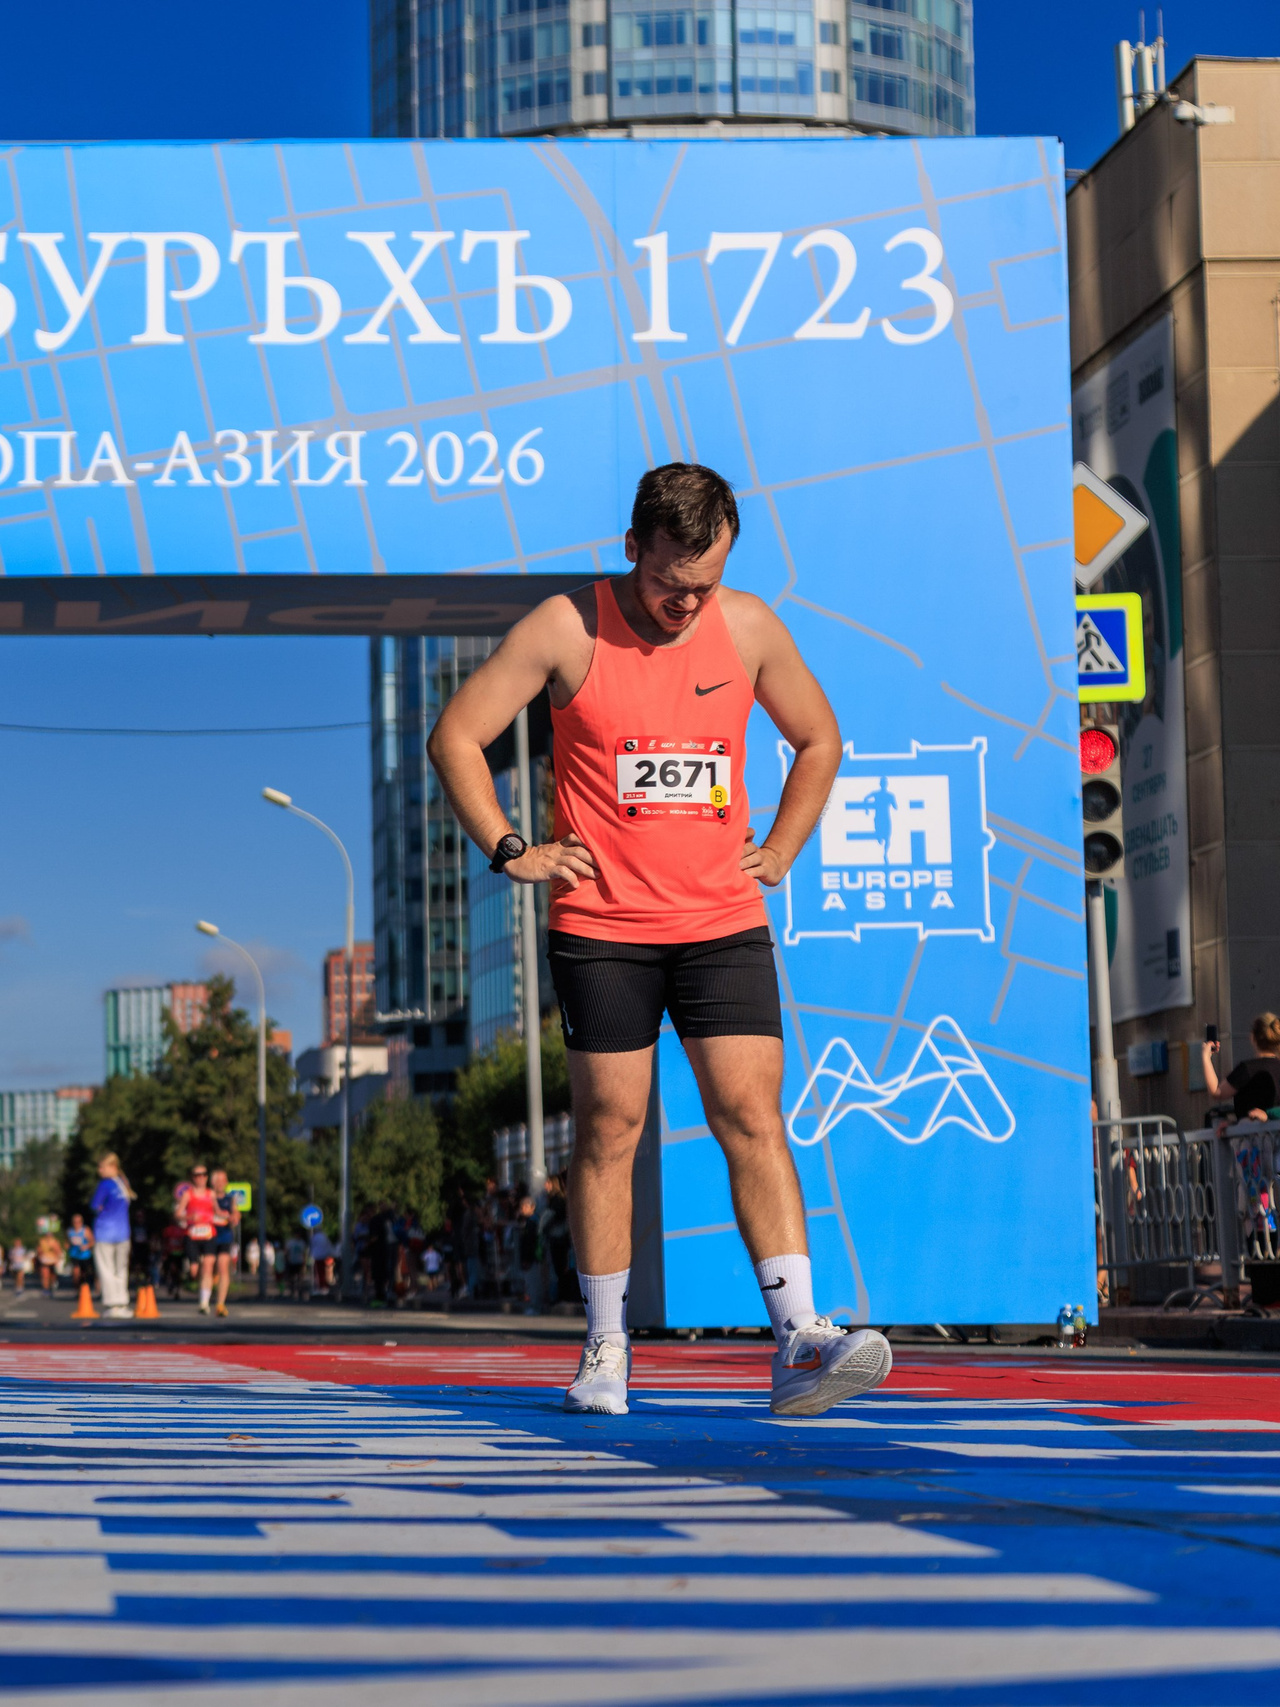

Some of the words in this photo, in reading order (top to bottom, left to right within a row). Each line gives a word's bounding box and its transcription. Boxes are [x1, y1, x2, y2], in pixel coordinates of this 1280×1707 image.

[632, 227, 956, 345] 1723
[386, 426, 546, 488] 2026
[635, 759, 717, 788] 2671
[664, 791, 693, 799] ДМИТРИЙ
[1124, 812, 1179, 855] ДВЕНАДЦАТЬ
[1133, 846, 1170, 880] СТУЛЬЕВ
[822, 869, 954, 890] EUROPE
[822, 890, 955, 911] ASIA
